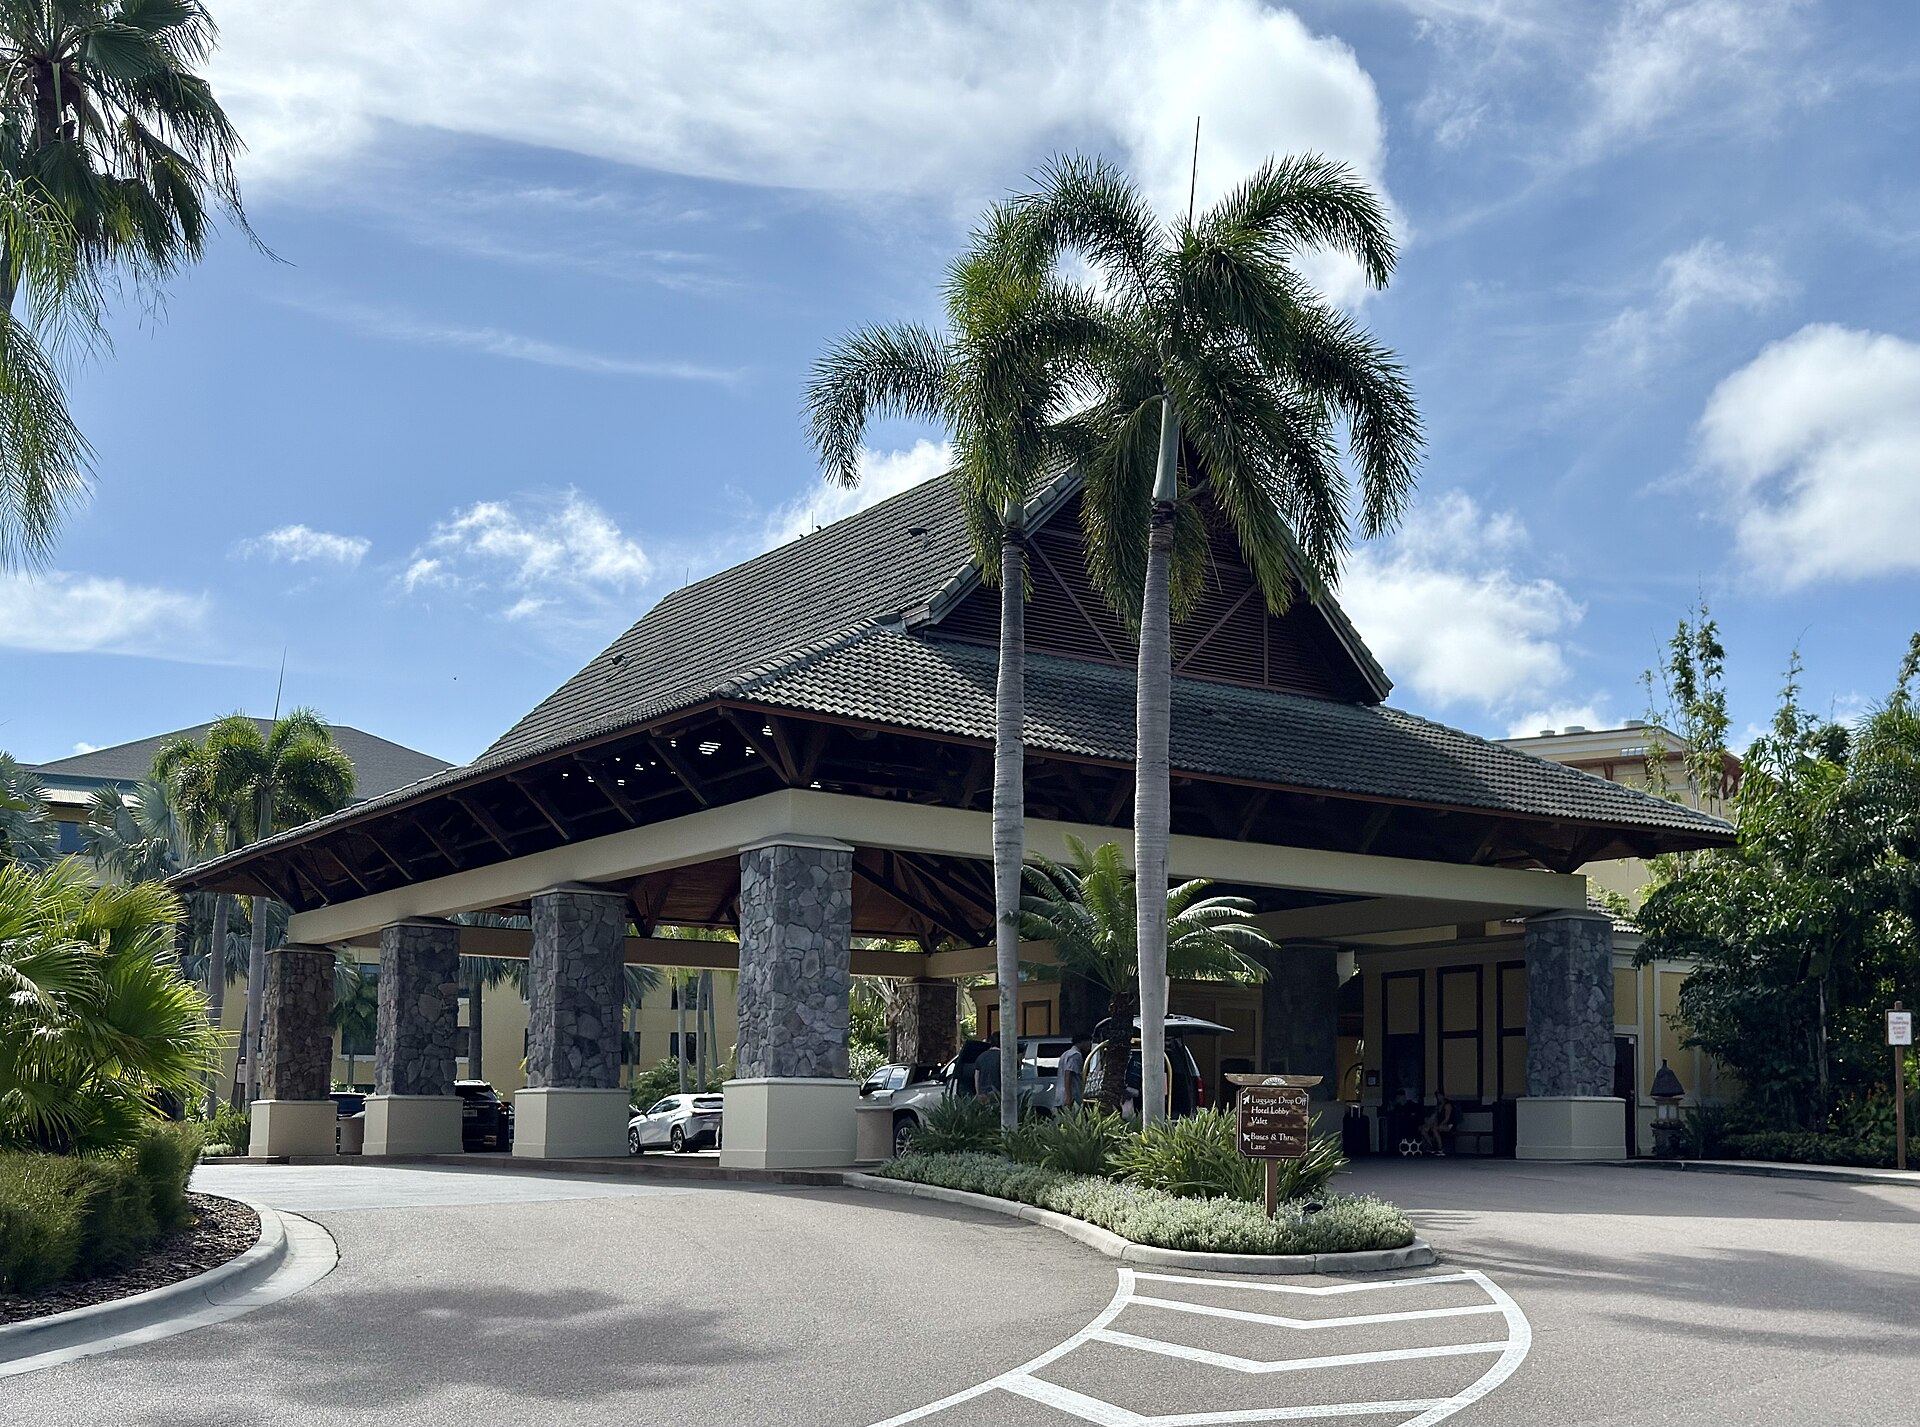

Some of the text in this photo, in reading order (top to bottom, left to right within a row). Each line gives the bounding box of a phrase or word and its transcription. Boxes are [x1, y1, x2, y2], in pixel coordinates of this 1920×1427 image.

[1251, 1095, 1307, 1106] Luggage Drop Off
[1251, 1106, 1290, 1115] Hotel Lobby
[1251, 1116, 1268, 1125] Valet
[1250, 1132, 1269, 1140] Buses
[1250, 1141, 1266, 1150] Lane
